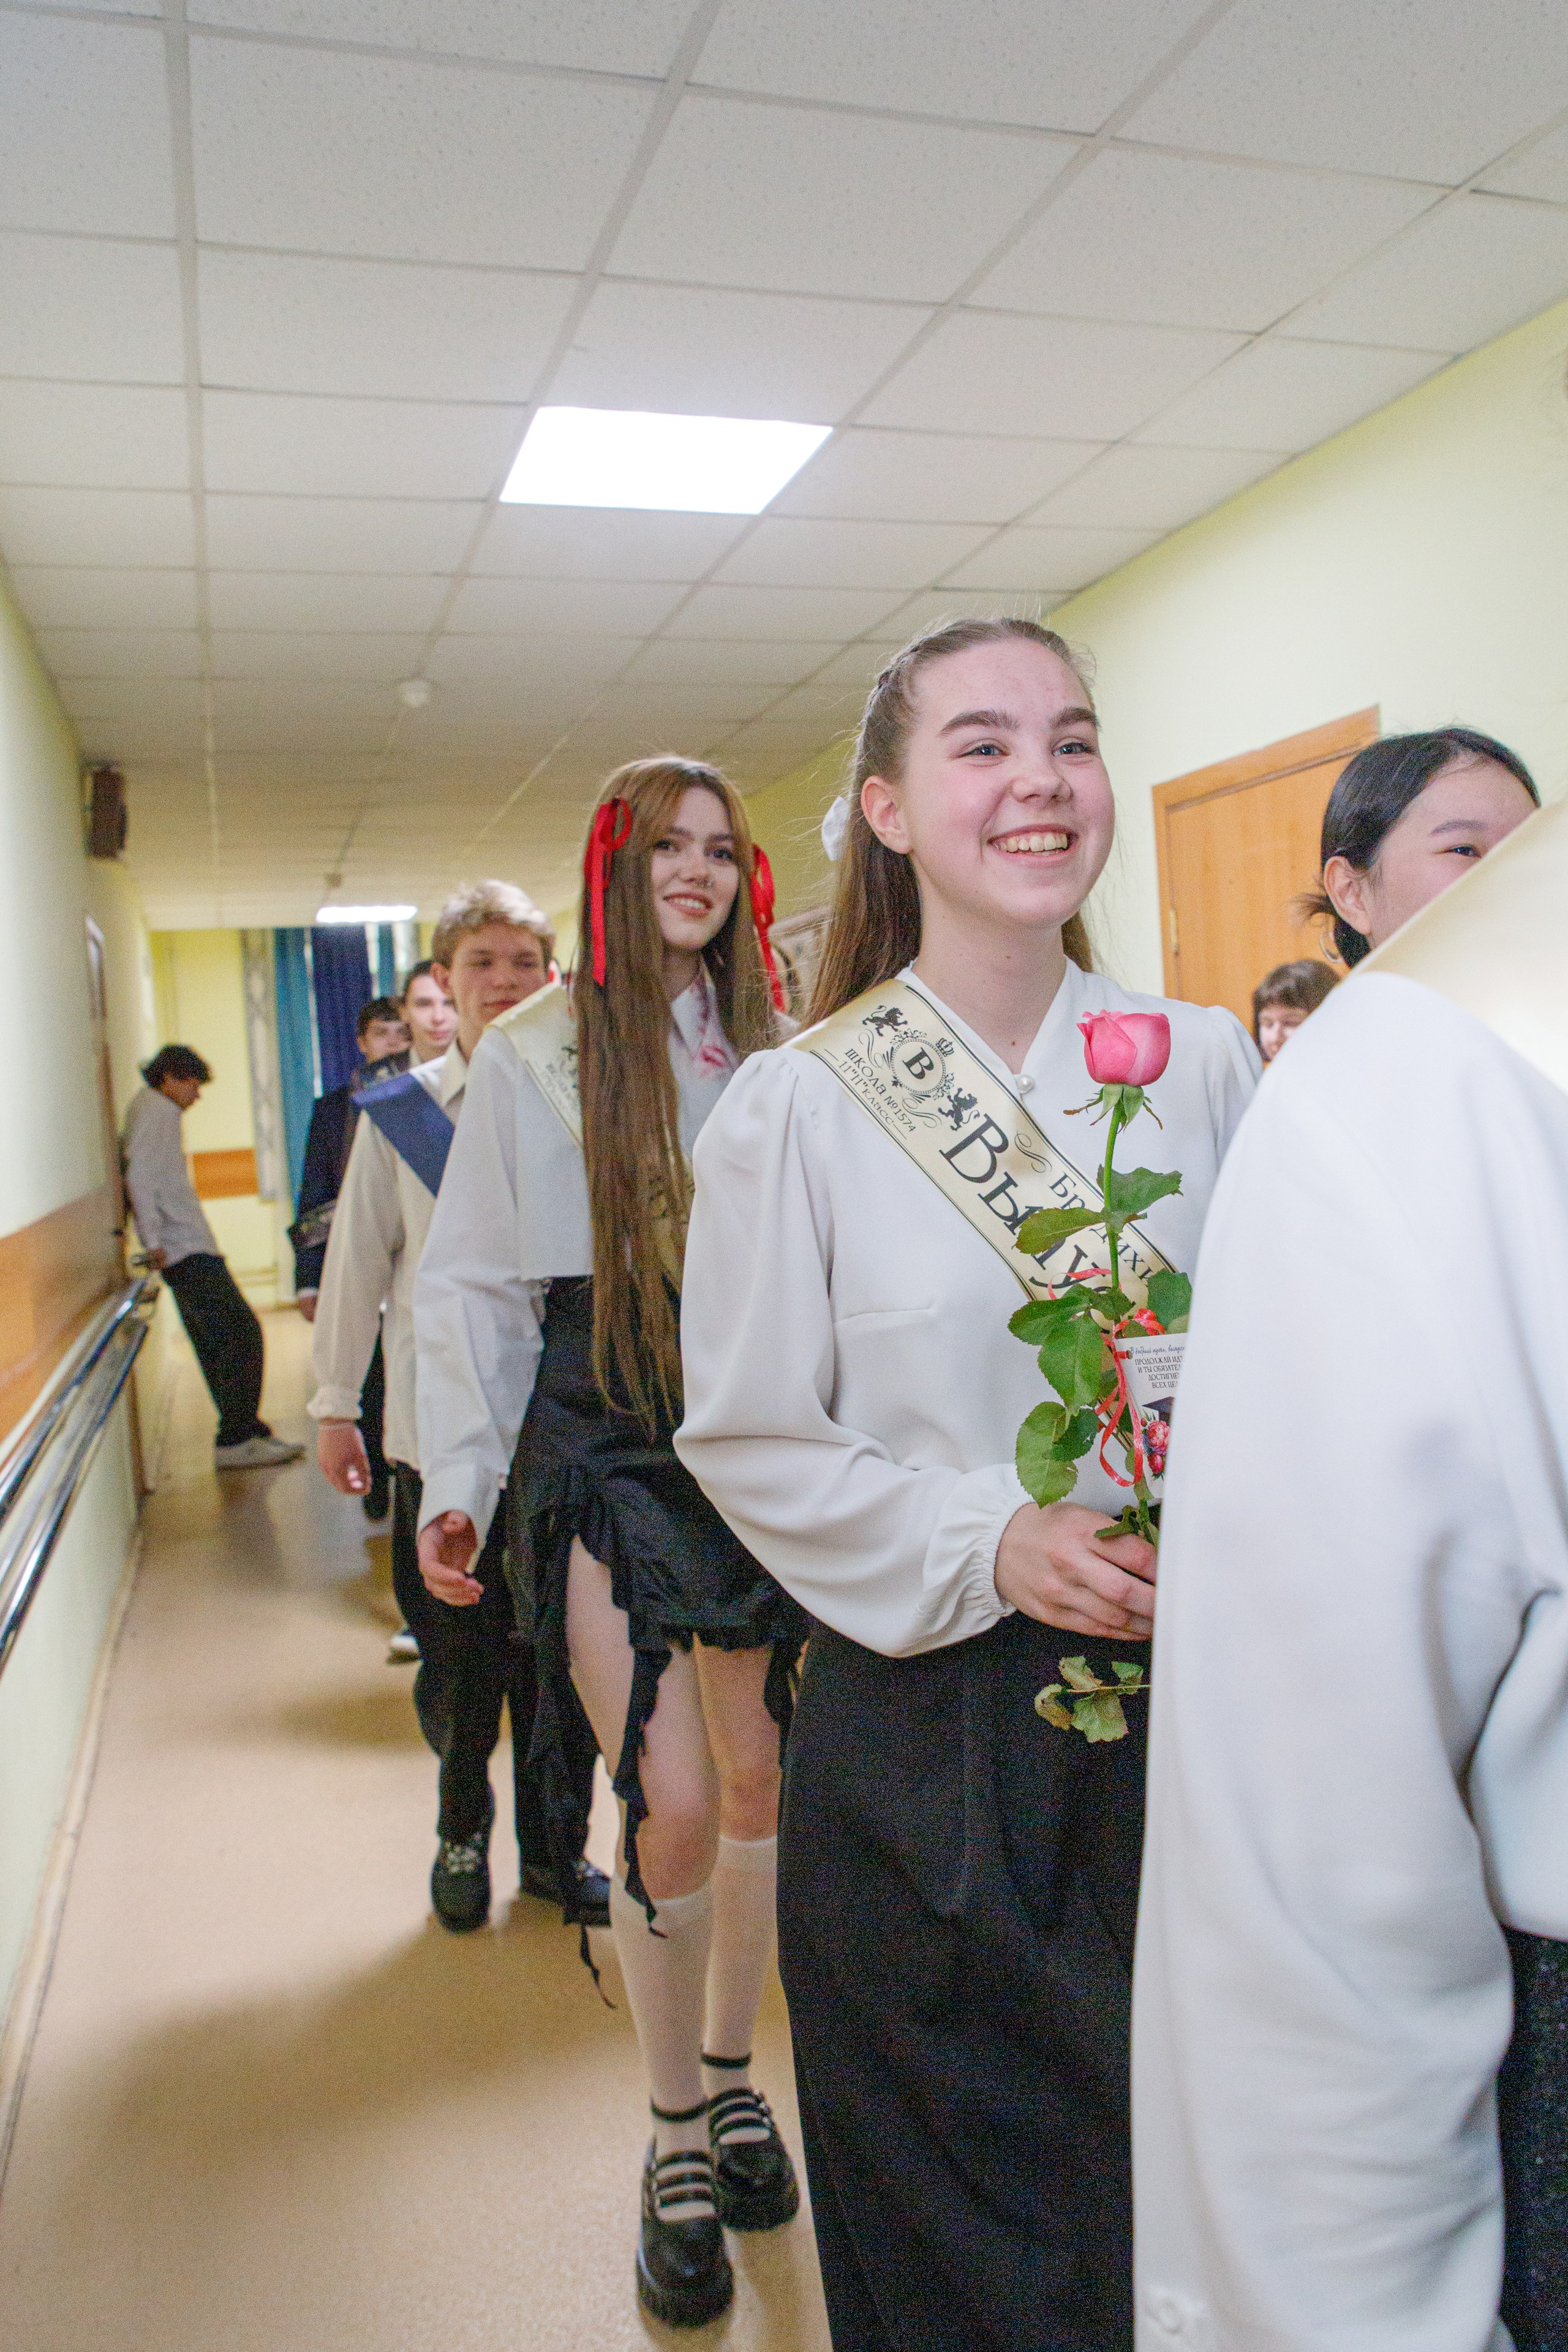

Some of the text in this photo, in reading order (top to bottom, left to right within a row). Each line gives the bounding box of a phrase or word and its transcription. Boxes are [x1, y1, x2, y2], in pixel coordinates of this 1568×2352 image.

[902, 1047, 934, 1080] В
[938, 1113, 1112, 1298] Выу
[1135, 1356, 1171, 1365] ПРОДОЛЖАЙ
[1148, 1372, 1180, 1381] ДОСТИГНЕ
